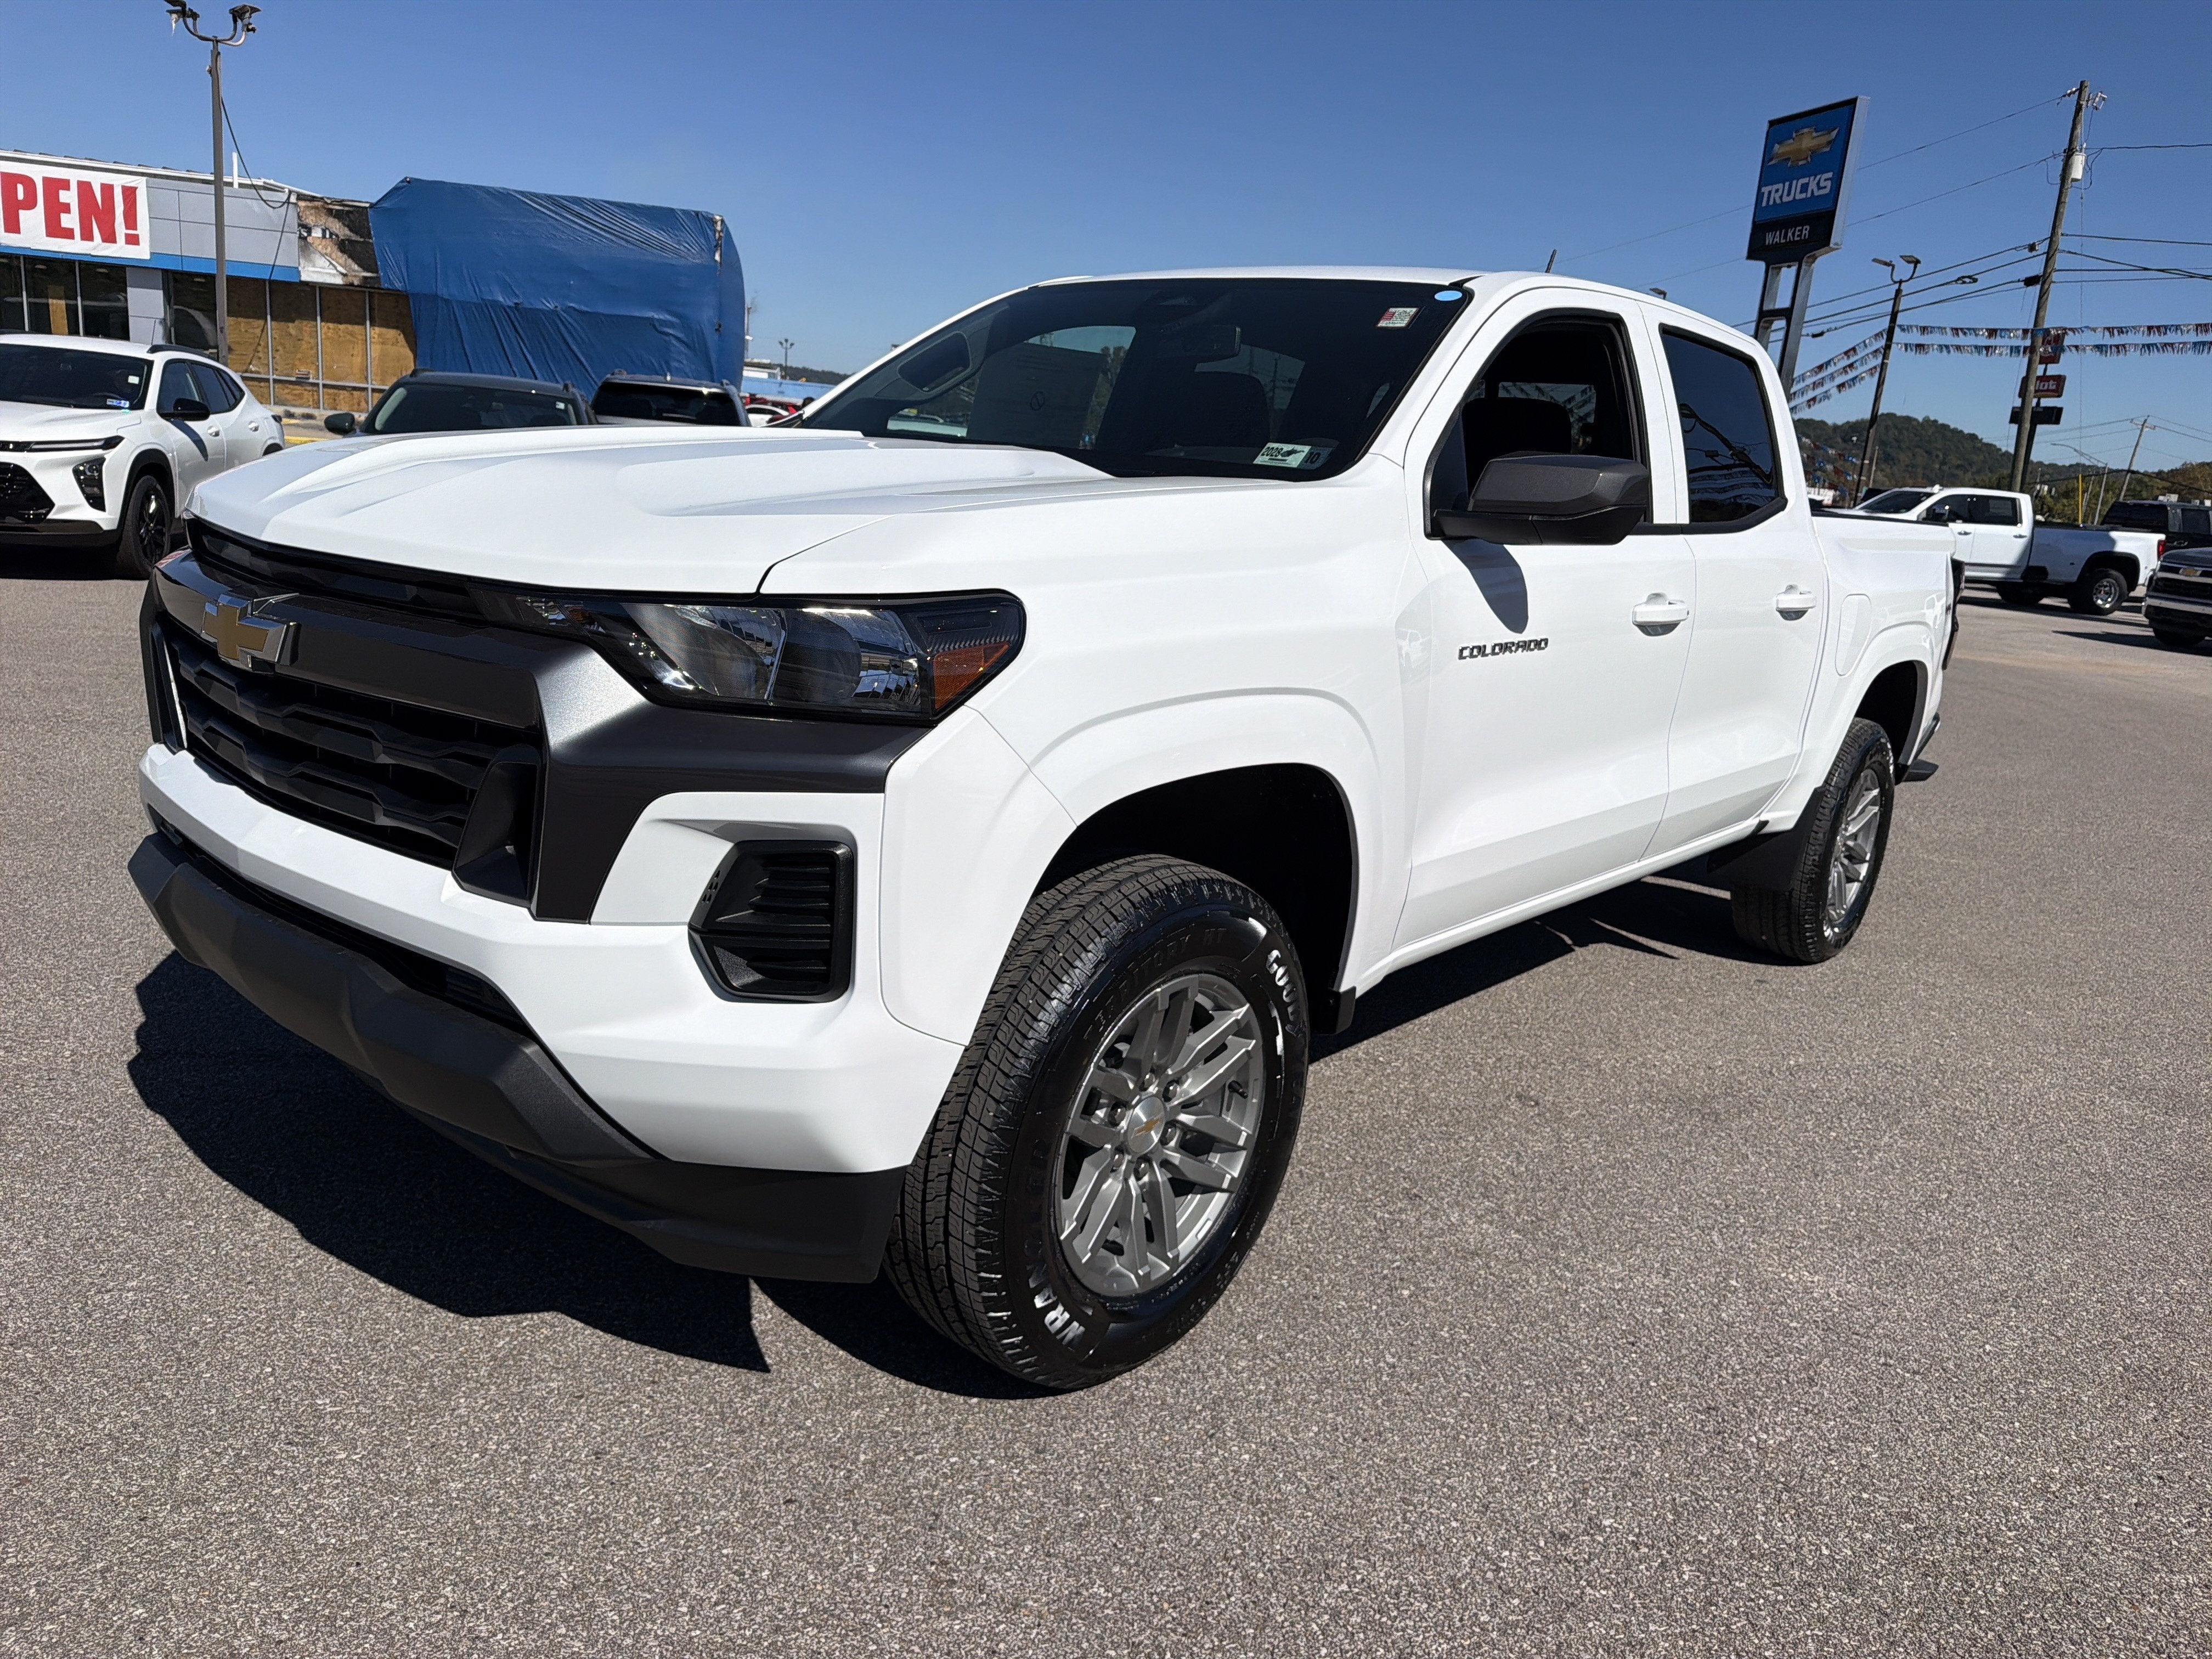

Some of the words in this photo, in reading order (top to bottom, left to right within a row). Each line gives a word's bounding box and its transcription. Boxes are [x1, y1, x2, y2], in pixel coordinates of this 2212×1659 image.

[1761, 171, 1833, 207] TRUCKS
[0, 172, 140, 246] PEN!
[1765, 225, 1810, 245] WALKER
[2035, 380, 2057, 390] lot
[1304, 451, 1322, 465] 10
[1458, 637, 1549, 661] COLORADO
